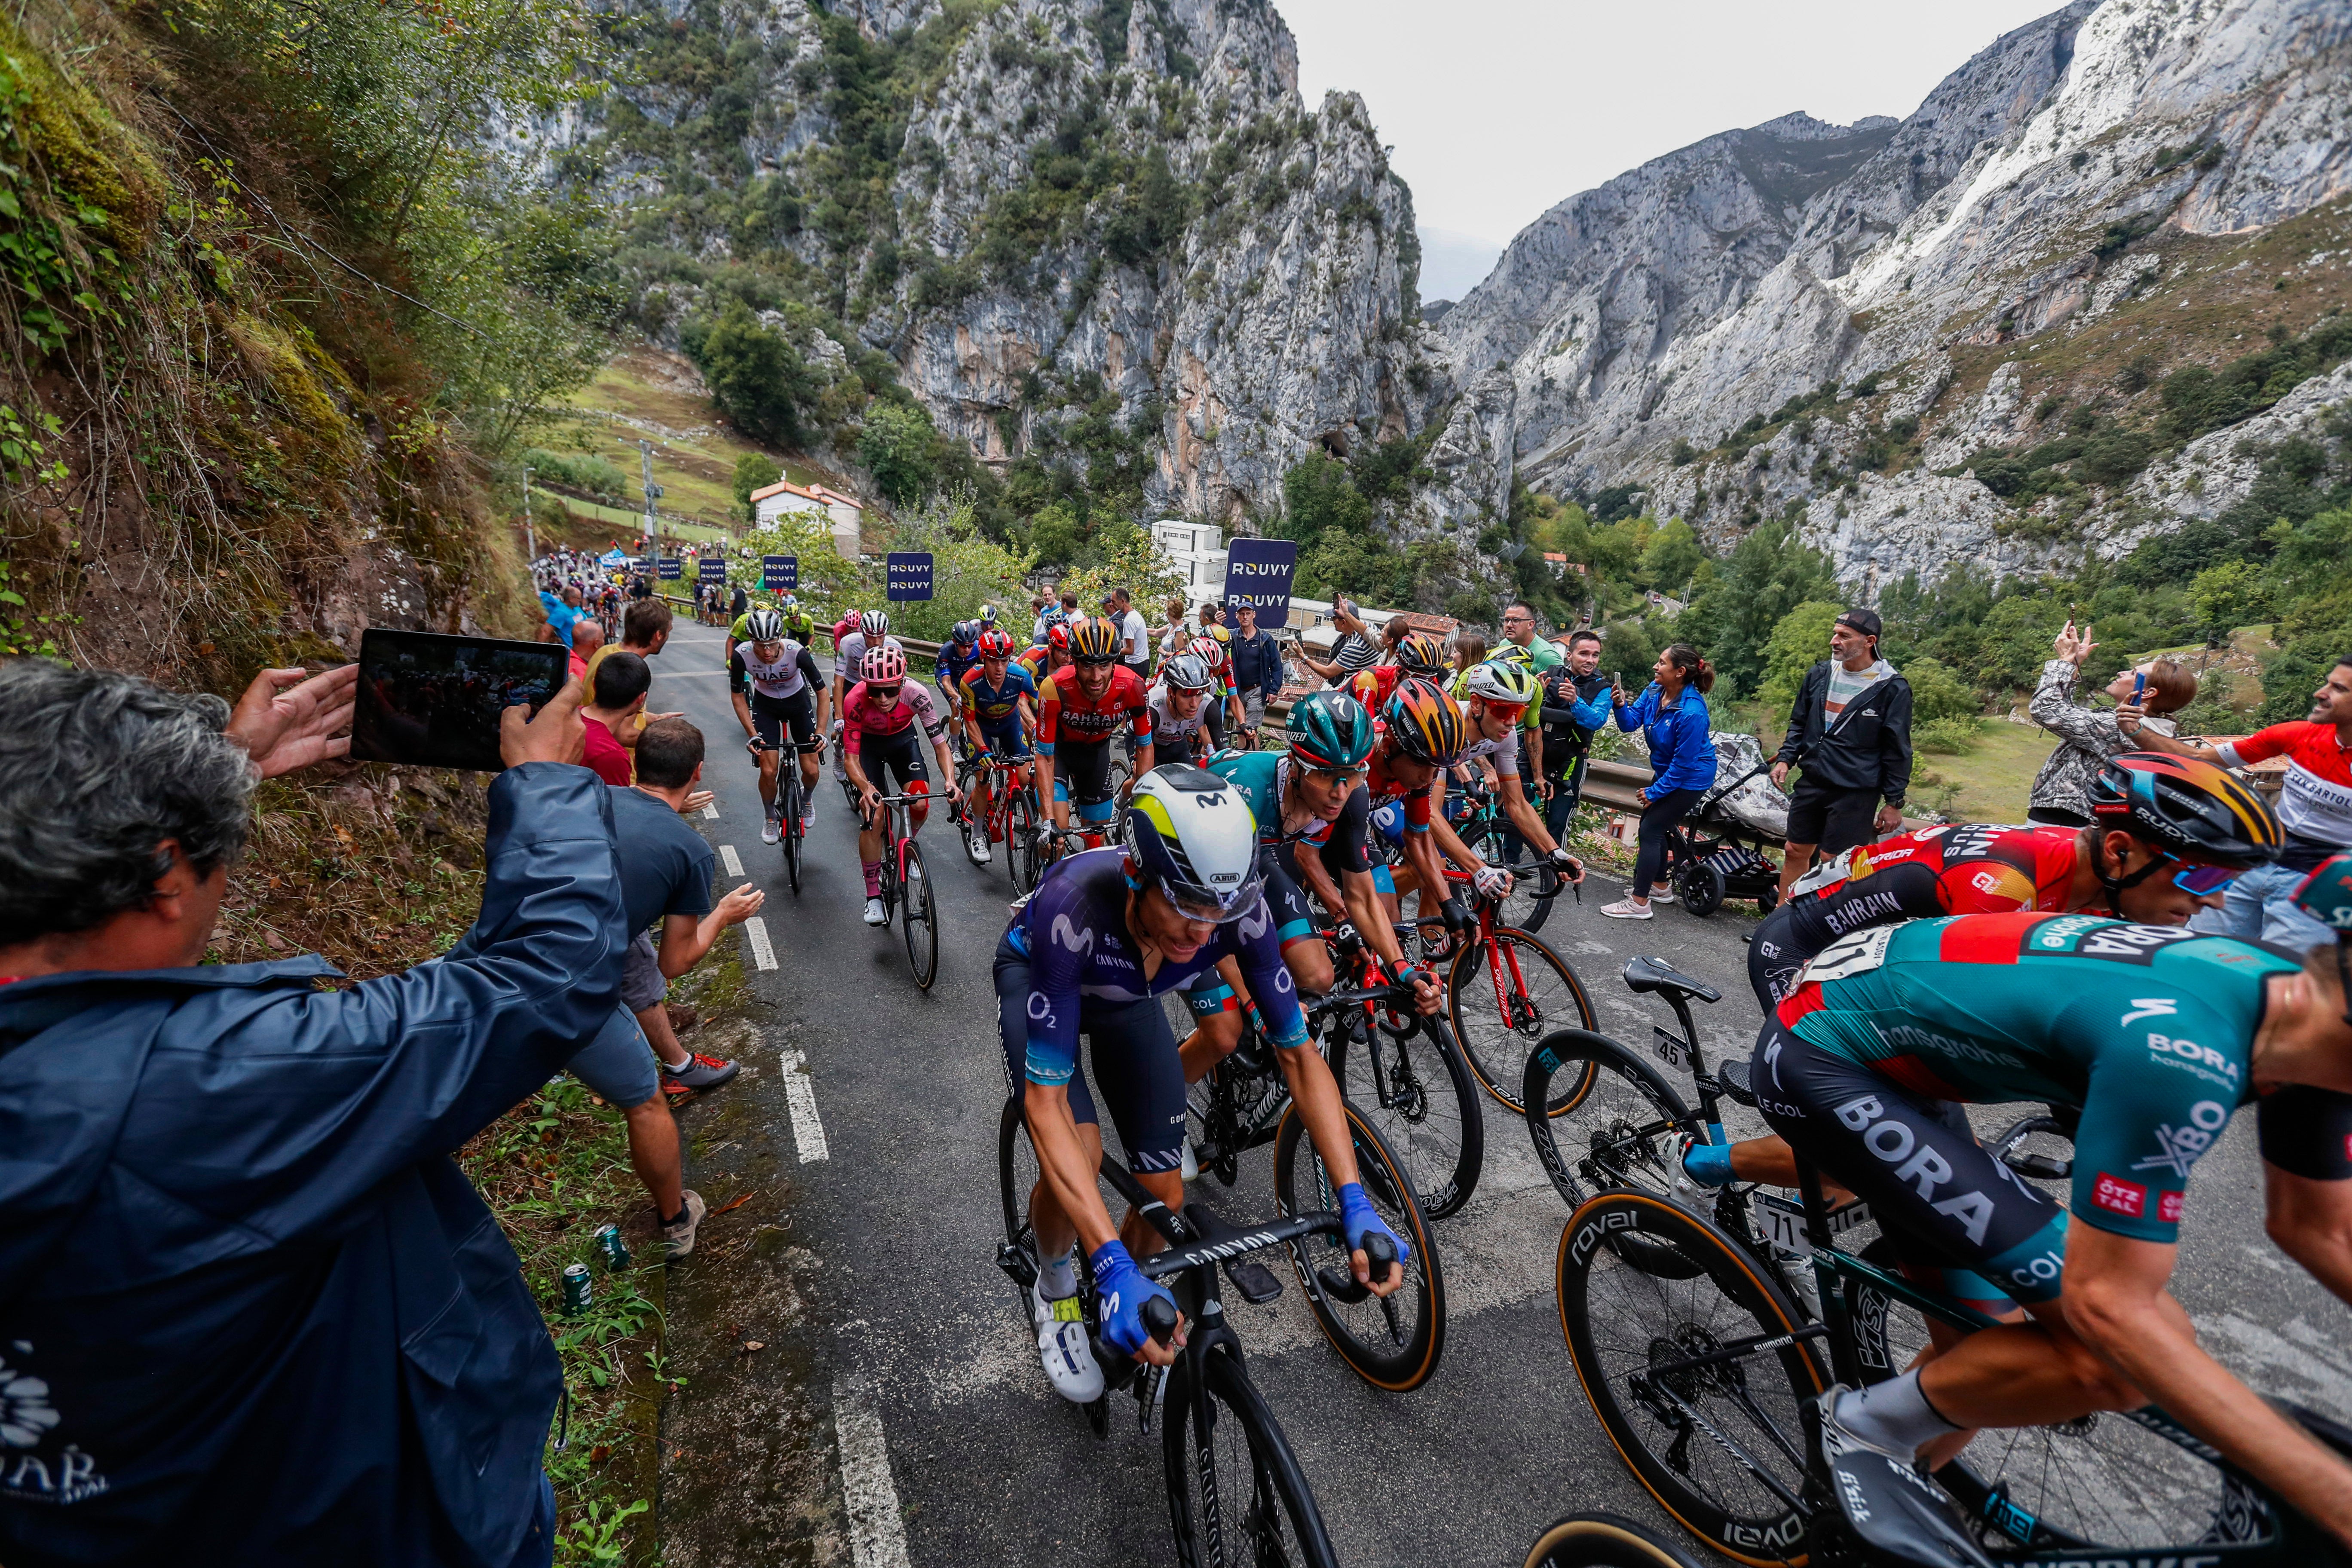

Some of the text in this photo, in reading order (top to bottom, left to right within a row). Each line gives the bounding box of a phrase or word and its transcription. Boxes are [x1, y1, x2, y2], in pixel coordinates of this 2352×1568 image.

[1232, 563, 1289, 576] ROUVY
[1228, 594, 1286, 606] ROUVY
[755, 672, 789, 680] UAE
[969, 677, 984, 688] TREK
[1038, 696, 1047, 738] MERIDA
[1062, 710, 1124, 722] BAHRAIN
[1143, 693, 1152, 726] MERIDA
[992, 779, 1010, 829] TREK
[2291, 774, 2309, 789] SAN
[2309, 783, 2352, 808] BARTOL
[2135, 806, 2198, 843] RUDY
[1126, 824, 1139, 863] ABUS
[1861, 848, 1915, 868] MERIDA
[1824, 891, 1903, 935] BAHRAIN
[2082, 925, 2195, 956] ORA
[1096, 954, 1135, 970] CANYON
[1274, 967, 1295, 994] O
[1493, 966, 1508, 1018] SPECIALIZED
[1192, 998, 1216, 1009] COL
[1659, 1042, 1678, 1066] 45
[1869, 1021, 2025, 1069] hansgrohe
[2147, 1032, 2239, 1083] BORA
[1696, 1079, 1719, 1089] BAHRAIN
[1696, 1084, 1720, 1093] VICTORIOUS
[1757, 1094, 1807, 1118] LE COL
[1611, 1136, 1638, 1149] MERIDA
[1833, 1094, 1995, 1247] BORA
[2099, 1193, 2136, 1214] TAL
[1571, 1210, 1637, 1266] roval
[1767, 1210, 1794, 1247] 71
[1184, 1231, 1280, 1266] CANYON
[1810, 1247, 1836, 1265] BORA
[1754, 1335, 1793, 1352] SHIMANO
[1724, 1512, 1804, 1548] oval
